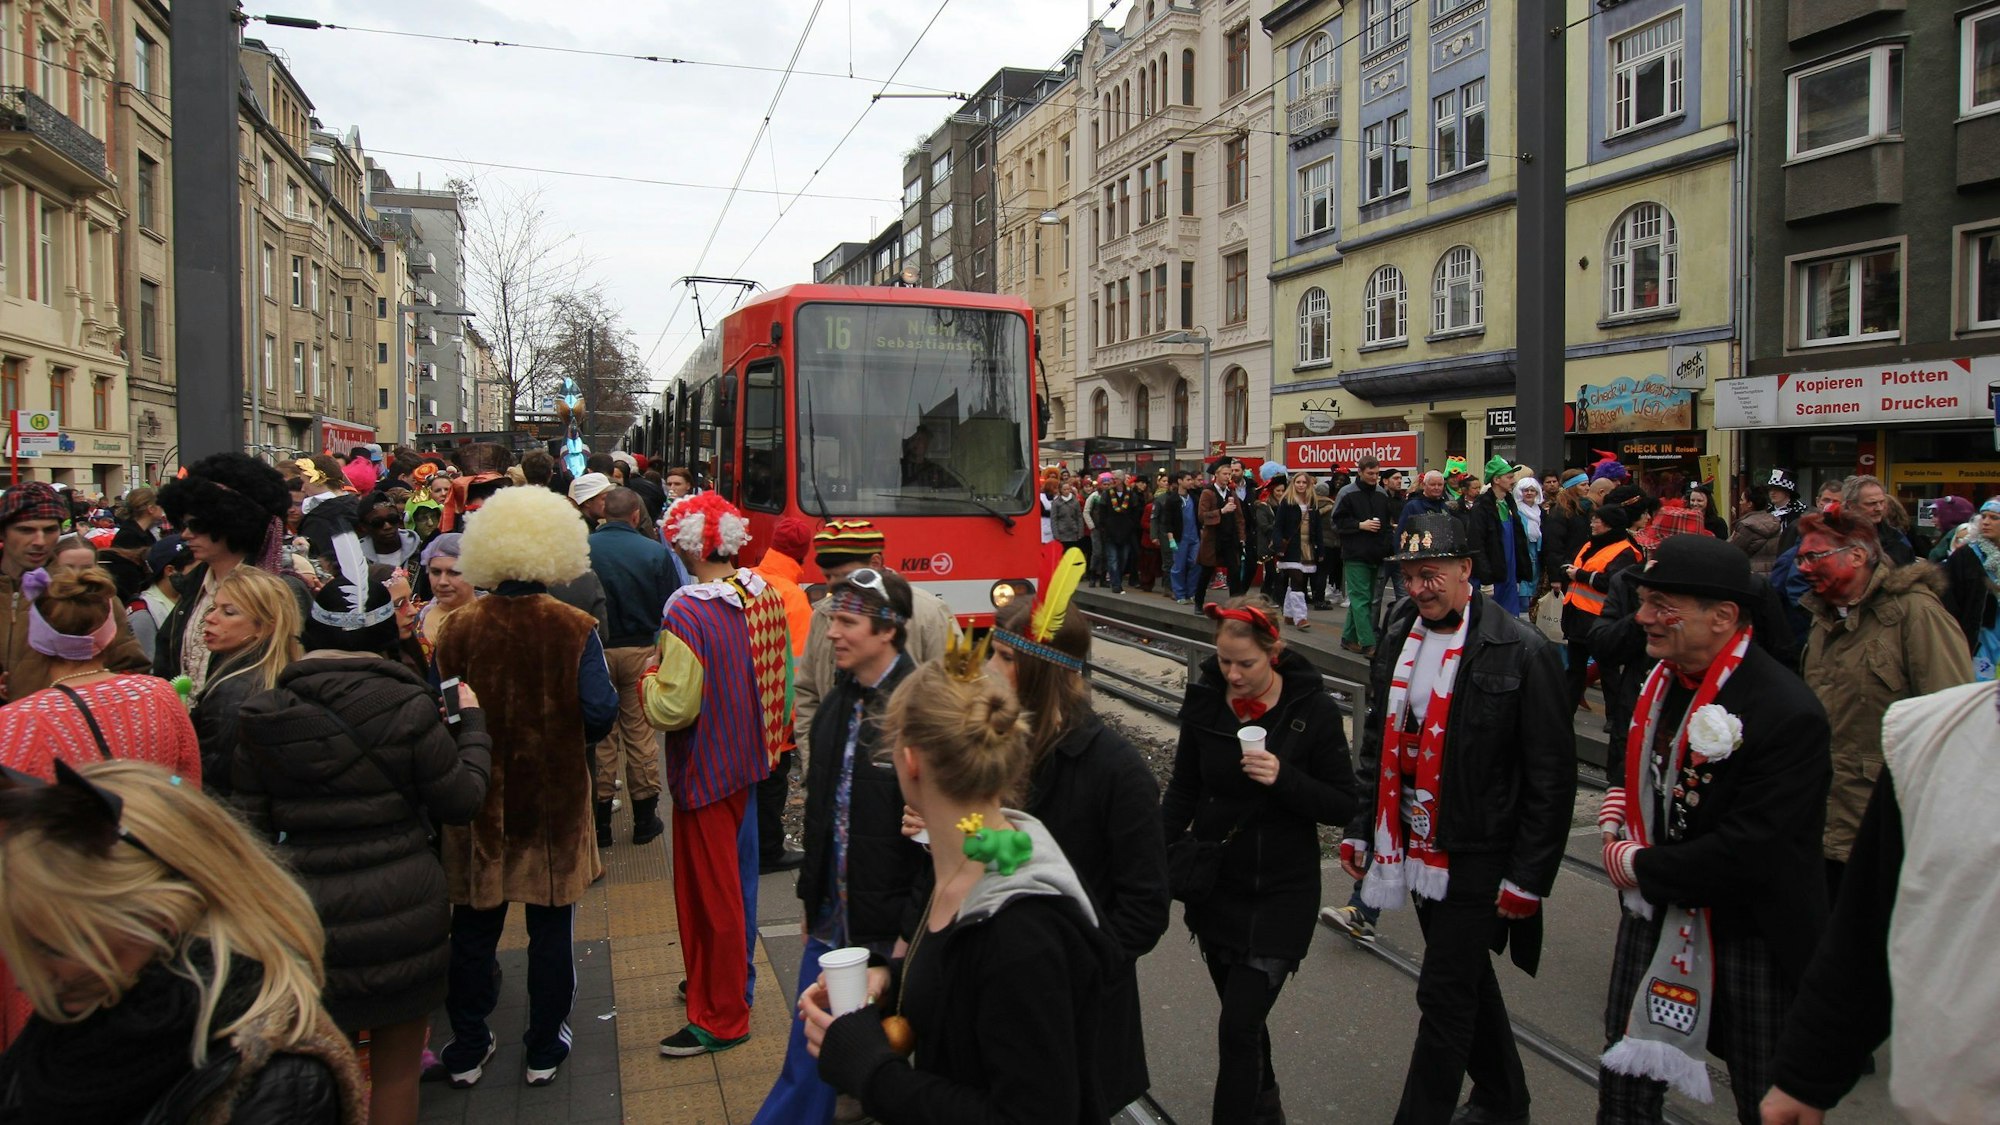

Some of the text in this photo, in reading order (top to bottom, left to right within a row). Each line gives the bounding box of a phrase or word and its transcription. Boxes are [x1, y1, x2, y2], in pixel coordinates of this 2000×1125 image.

[825, 315, 957, 350] 16 Niehl
[1676, 350, 1703, 377] check
[1695, 365, 1704, 379] in
[1795, 370, 1948, 393] Kopieren Plotten
[1796, 395, 1958, 415] Scannen Drucken
[1623, 444, 1657, 453] CHECK
[1661, 444, 1672, 453] IN
[901, 557, 931, 571] KVB
